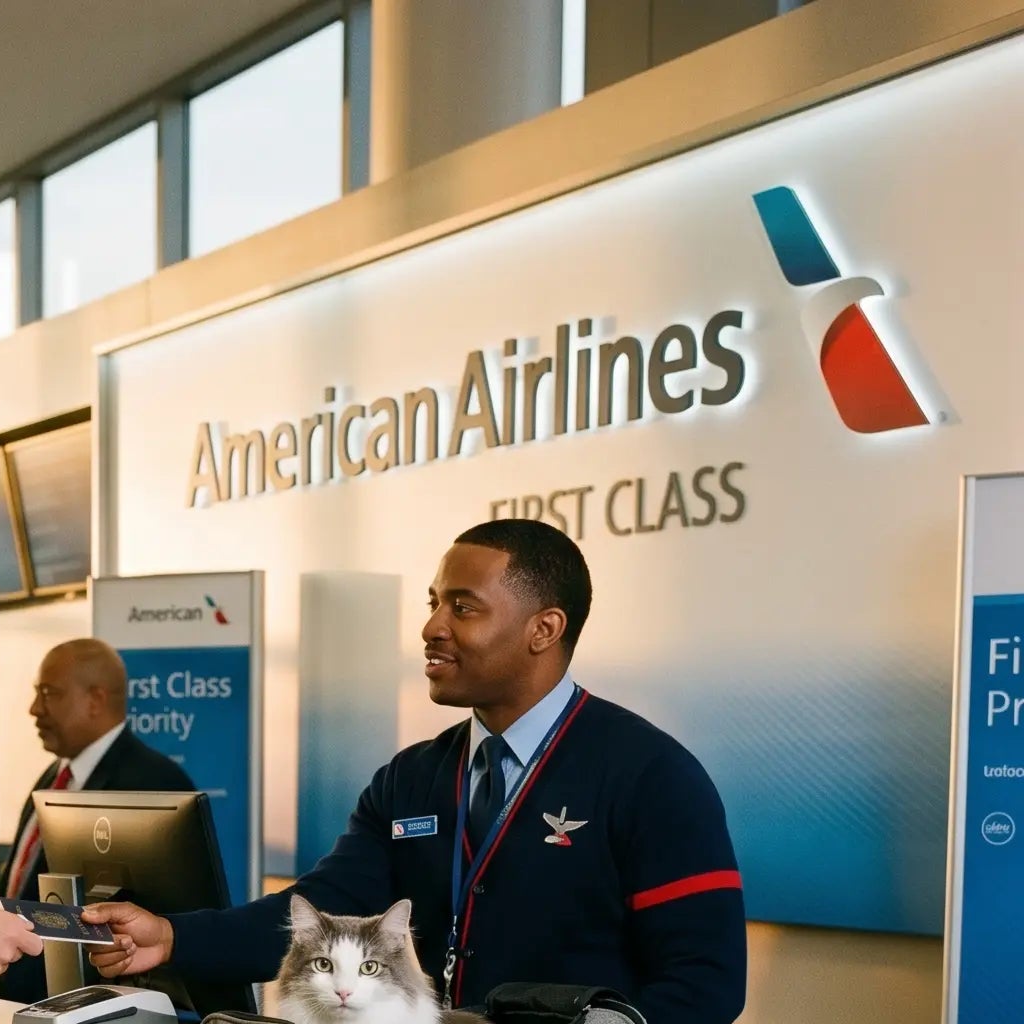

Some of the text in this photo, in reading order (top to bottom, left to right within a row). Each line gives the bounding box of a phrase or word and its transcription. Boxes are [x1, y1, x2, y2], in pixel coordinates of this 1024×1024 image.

[189, 309, 746, 509] American Airlines
[605, 461, 747, 537] CLASS
[128, 604, 203, 623] American
[988, 635, 1022, 675] Fi
[127, 670, 233, 699] rst Class
[126, 705, 195, 741] iority
[987, 690, 1024, 727] Pr
